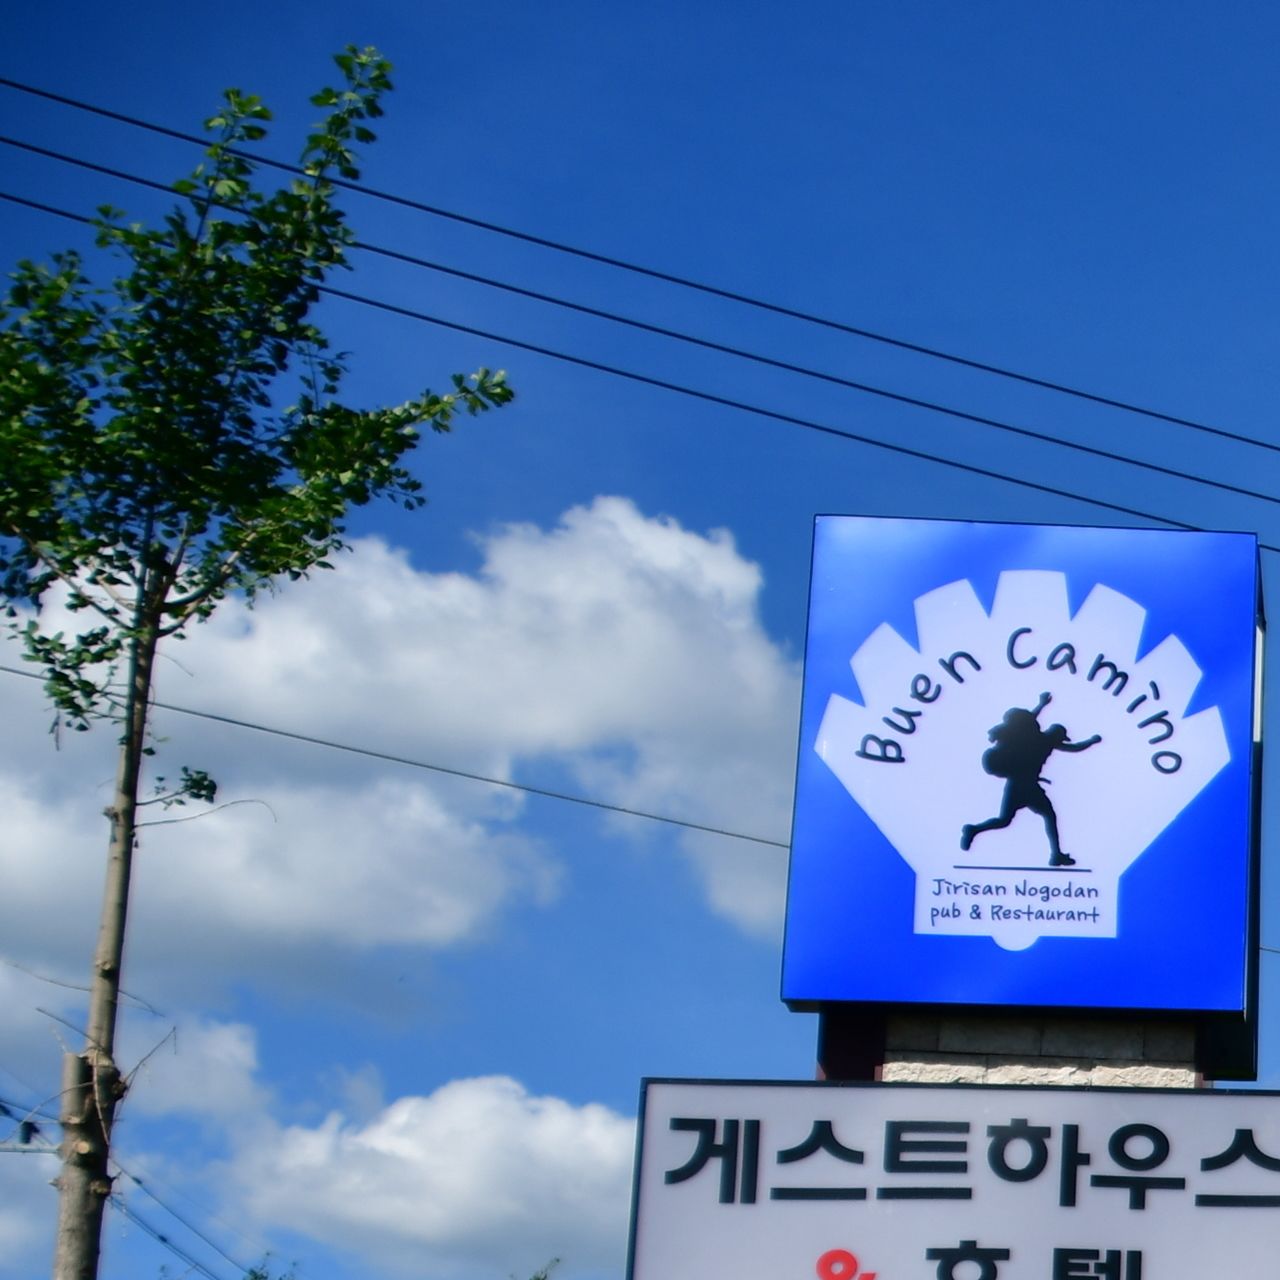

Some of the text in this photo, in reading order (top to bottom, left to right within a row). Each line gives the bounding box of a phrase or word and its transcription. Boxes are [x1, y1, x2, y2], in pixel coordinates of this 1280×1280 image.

[855, 626, 1182, 774] Buen Camino
[932, 878, 1099, 902] Jirisan Nogodan
[930, 902, 1100, 926] pub & Restaurant
